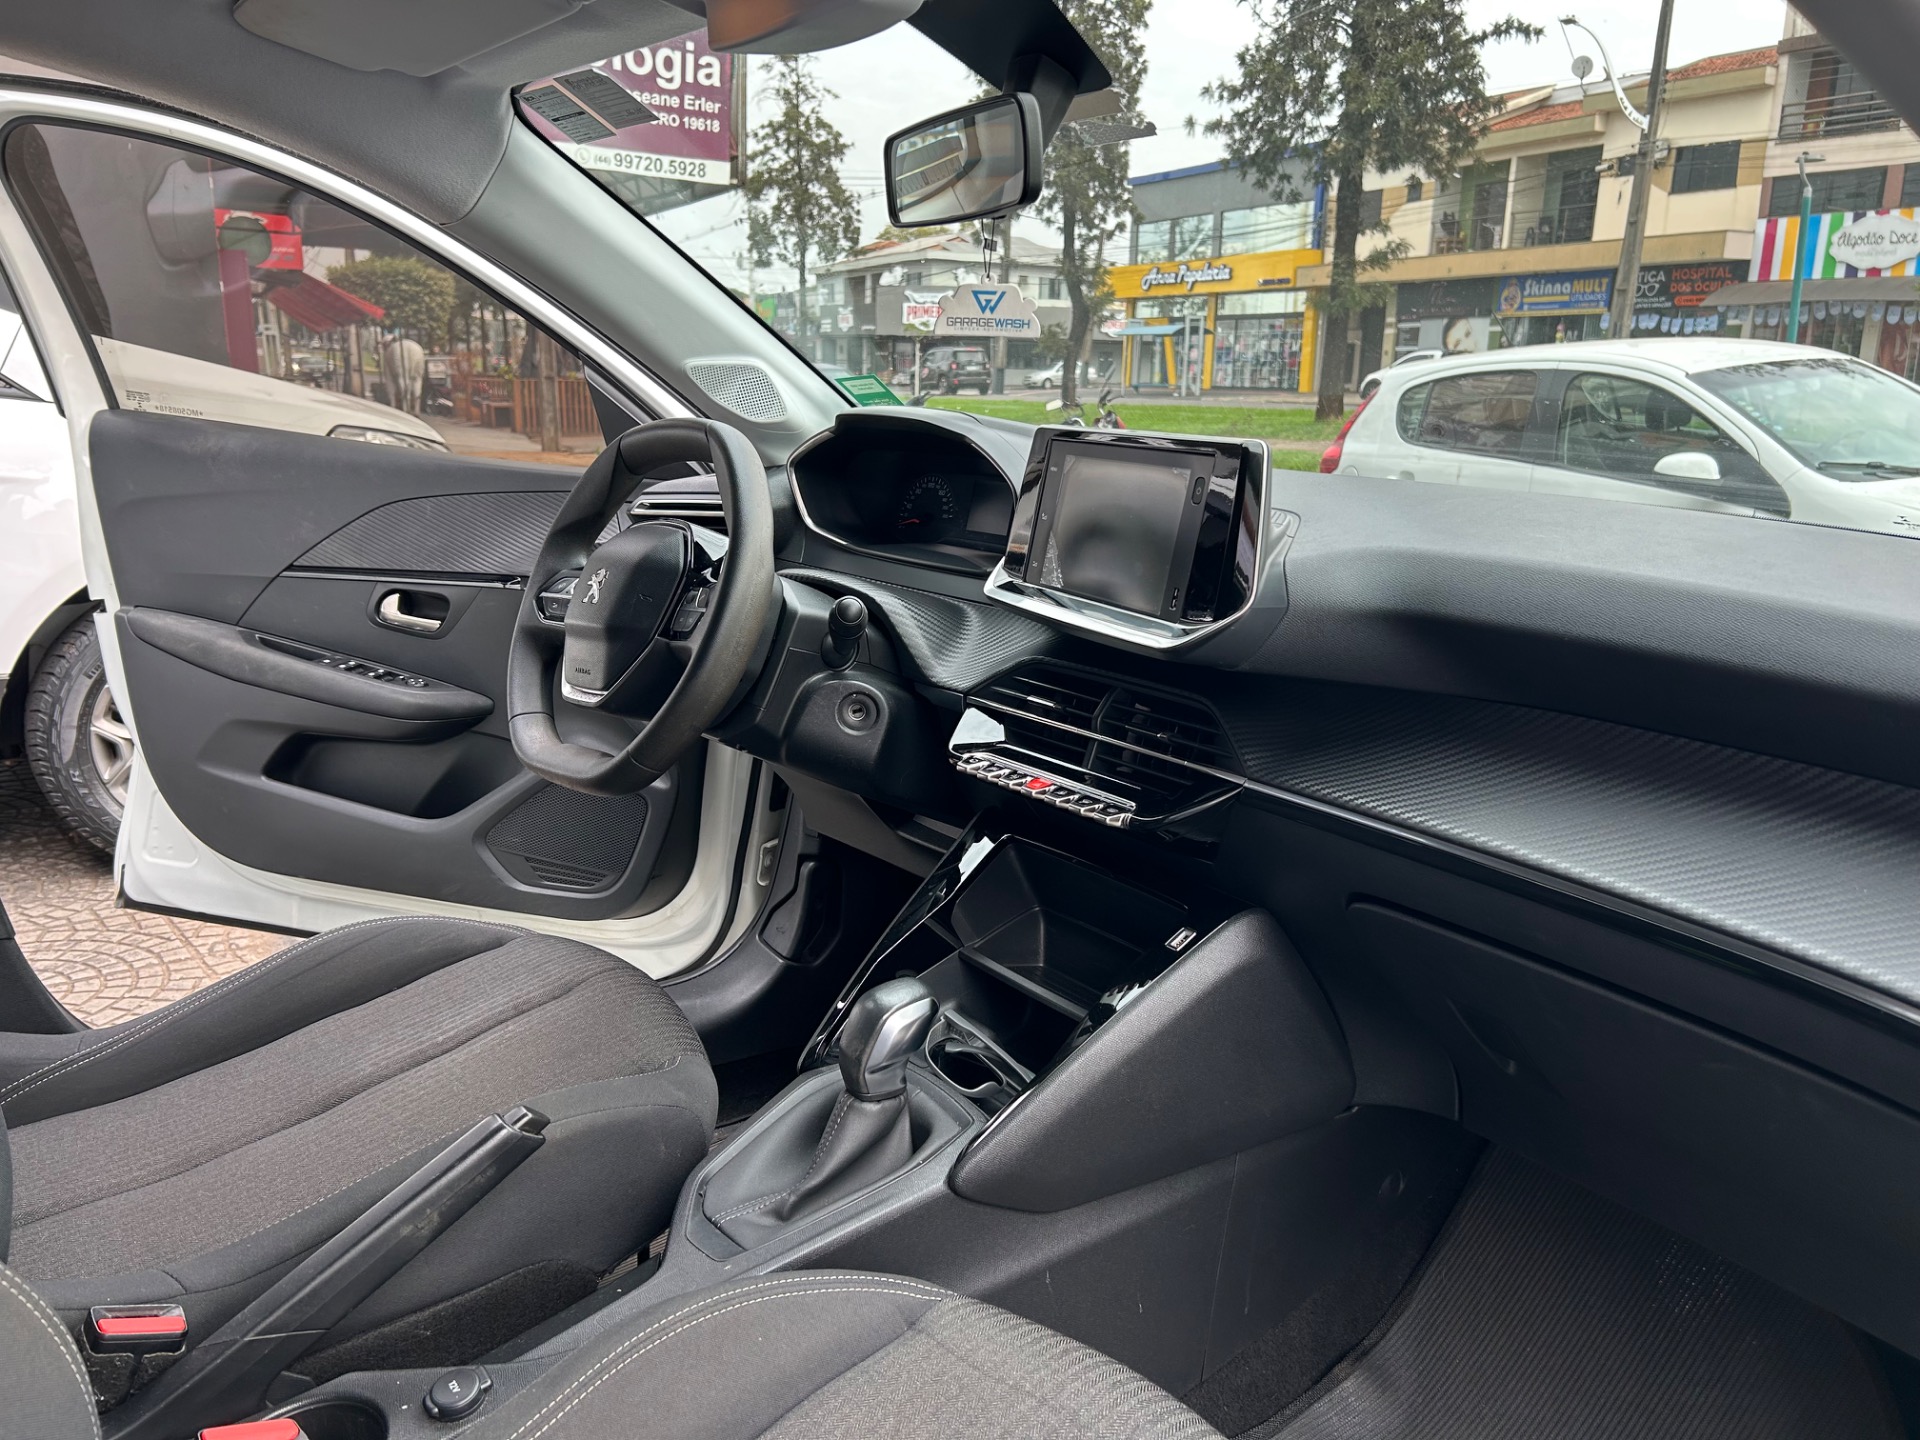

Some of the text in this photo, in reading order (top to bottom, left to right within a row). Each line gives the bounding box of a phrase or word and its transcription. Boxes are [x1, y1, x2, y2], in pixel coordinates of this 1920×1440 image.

[626, 89, 722, 114] seane Erler
[683, 115, 721, 133] 19618
[613, 152, 707, 178] 99720.5928
[1635, 270, 1666, 283] TICA
[1671, 266, 1733, 280] HOSPITAL
[1522, 277, 1609, 296] Skinna MULT
[1669, 282, 1692, 293] DOS
[946, 316, 1031, 330] GARAGEWASH
[574, 667, 592, 675] AIRBAG
[448, 1379, 461, 1393] 12V
